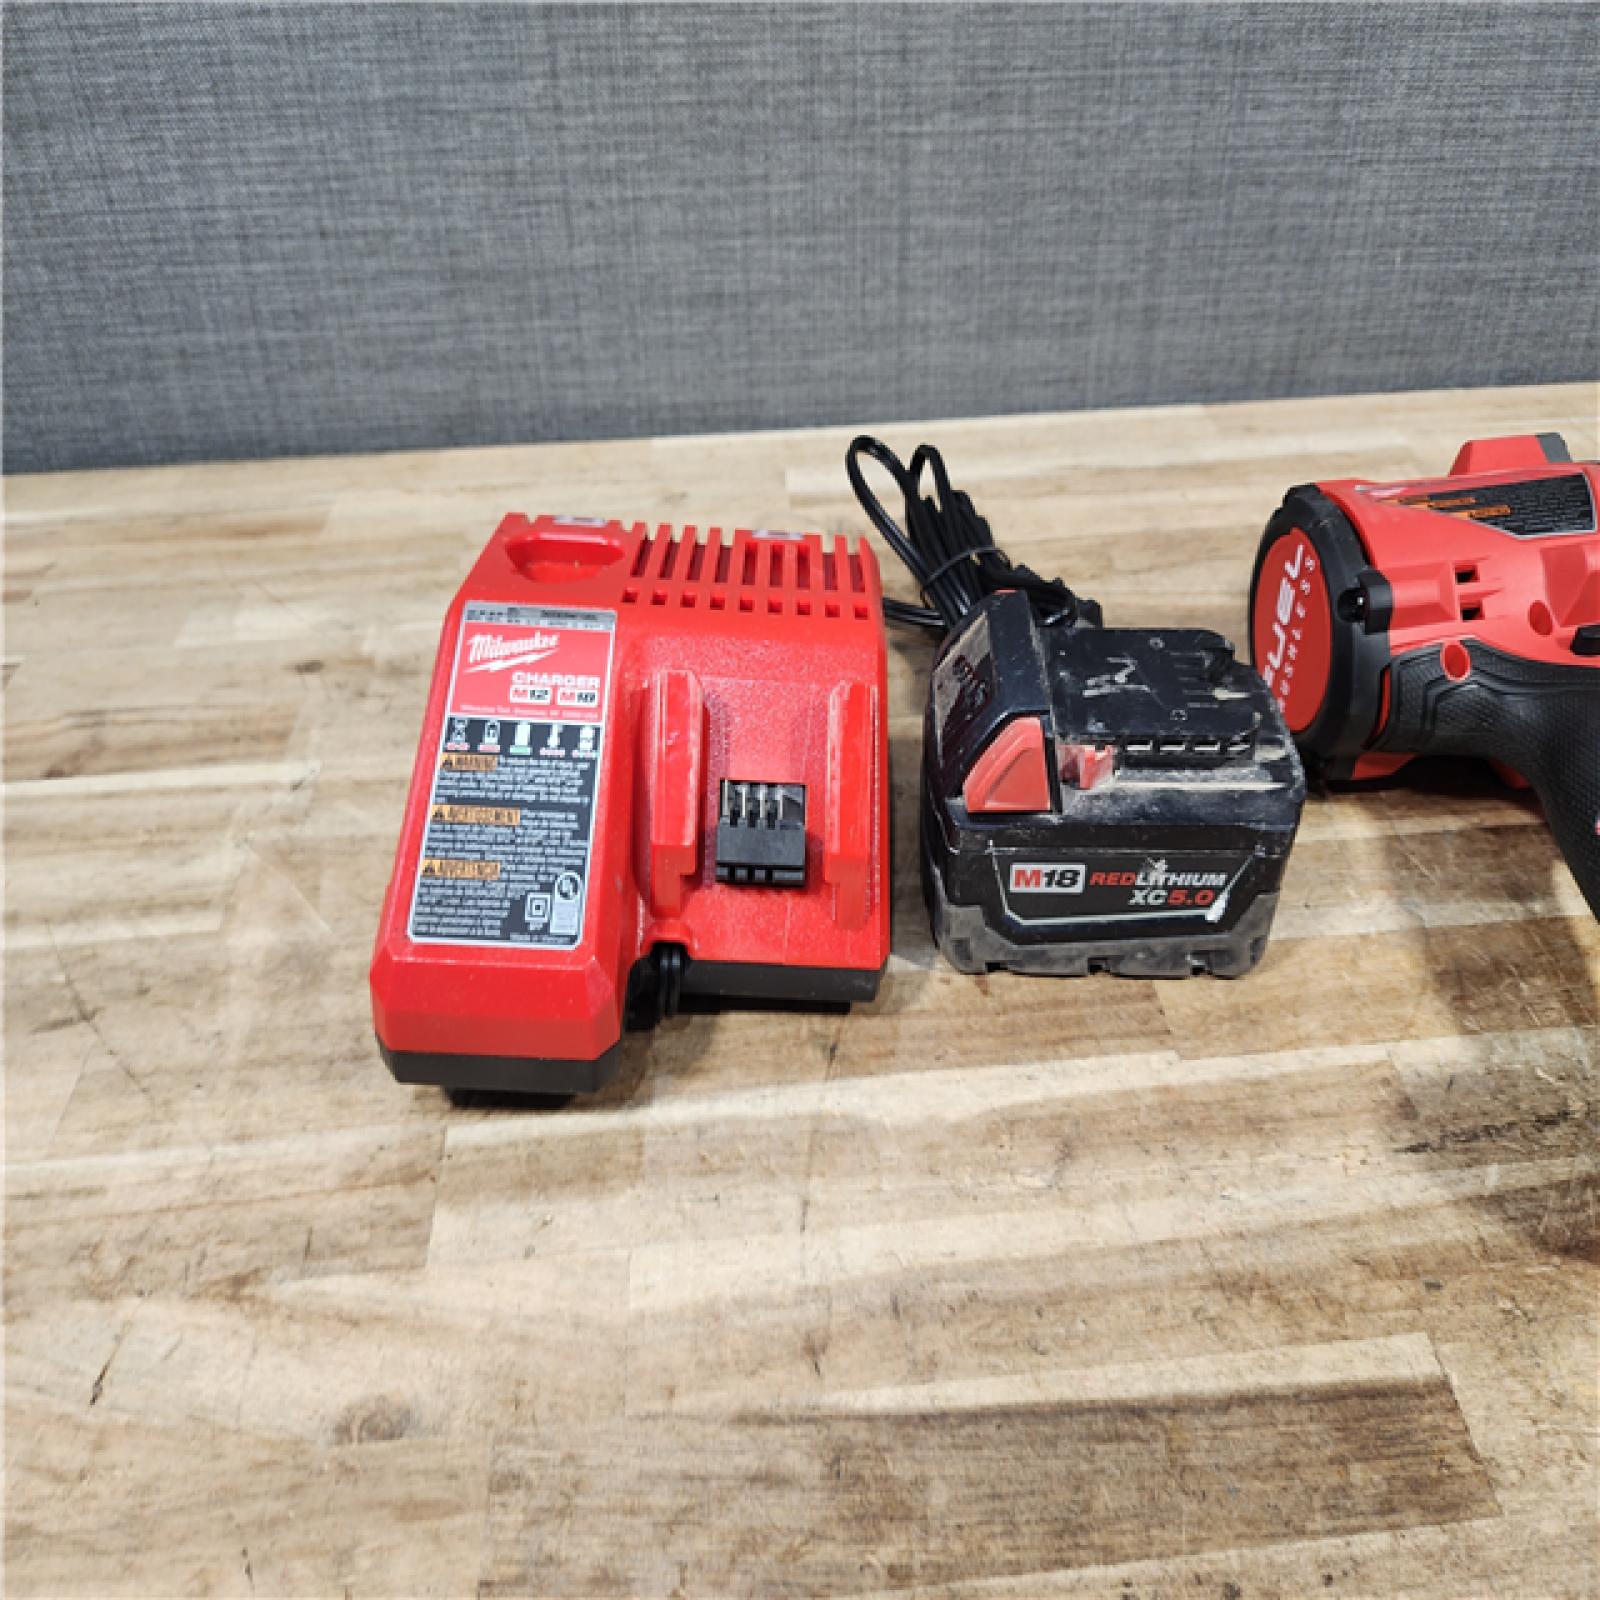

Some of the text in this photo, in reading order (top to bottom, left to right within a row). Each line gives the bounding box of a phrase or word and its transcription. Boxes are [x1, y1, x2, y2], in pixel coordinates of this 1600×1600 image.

[466, 630, 560, 663] Milwaukee
[512, 671, 600, 689] CHARGER
[1013, 868, 1081, 889] M18
